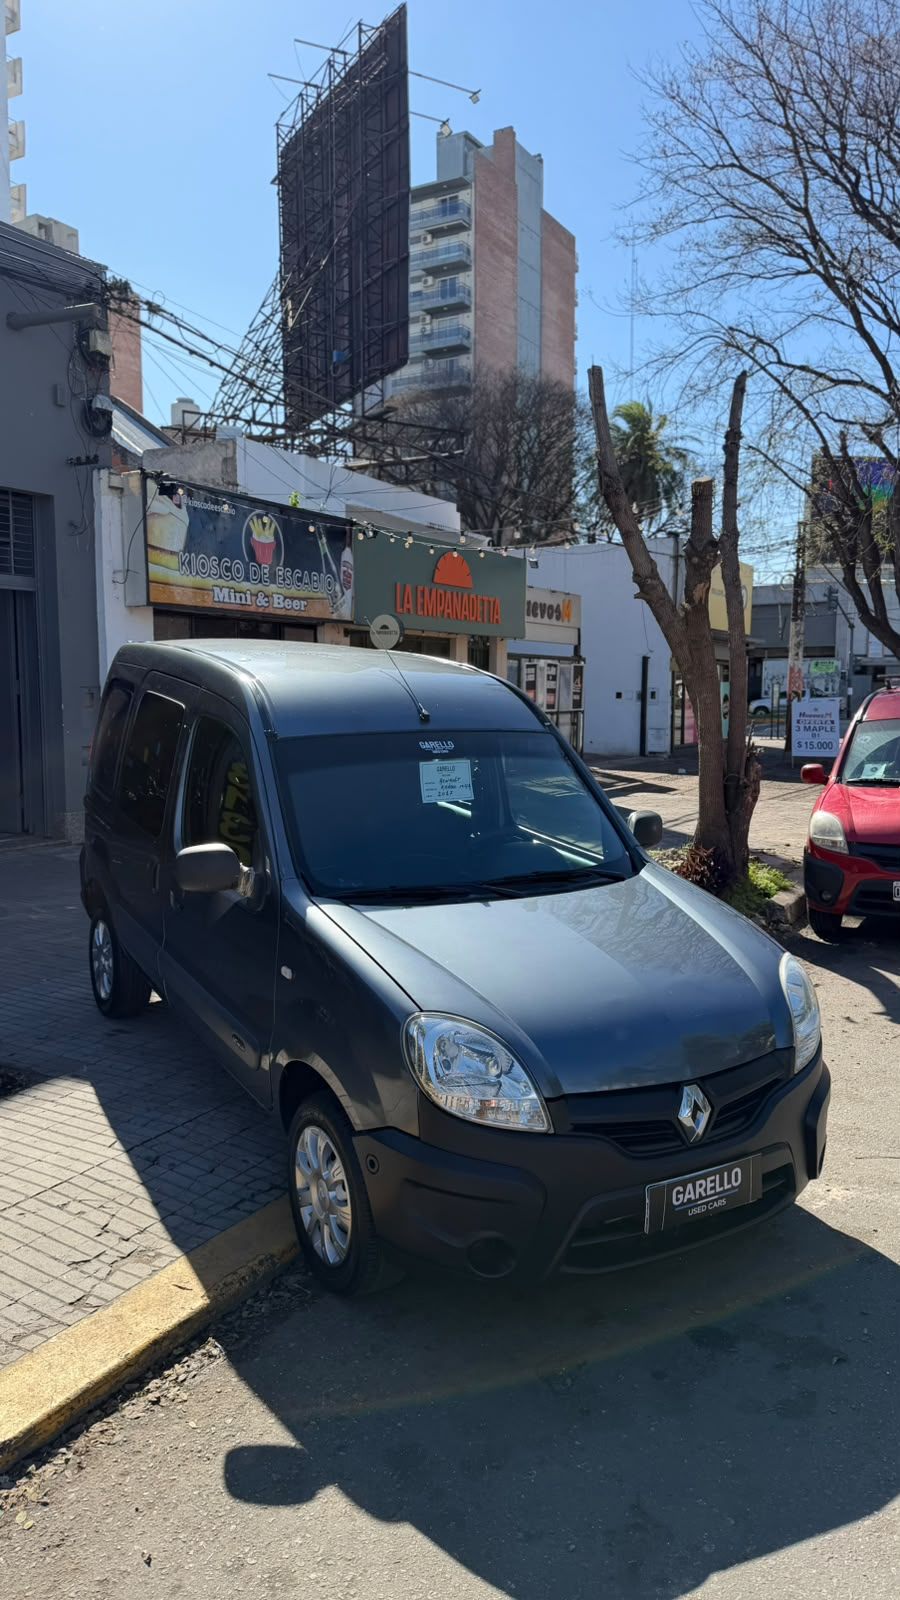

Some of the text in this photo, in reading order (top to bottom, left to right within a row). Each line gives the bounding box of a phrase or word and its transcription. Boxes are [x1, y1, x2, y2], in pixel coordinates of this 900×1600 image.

[178, 551, 245, 582] KIOSCO
[250, 562, 271, 585] DE
[276, 566, 336, 594] ESCABIO
[212, 586, 308, 612] Mini & Beer
[396, 583, 501, 624] LA EMPANADETTA
[419, 741, 454, 749] GARELLO
[804, 741, 833, 749] 15.000
[672, 1167, 741, 1205] GARELLO
[688, 1198, 726, 1216] USED CARS
